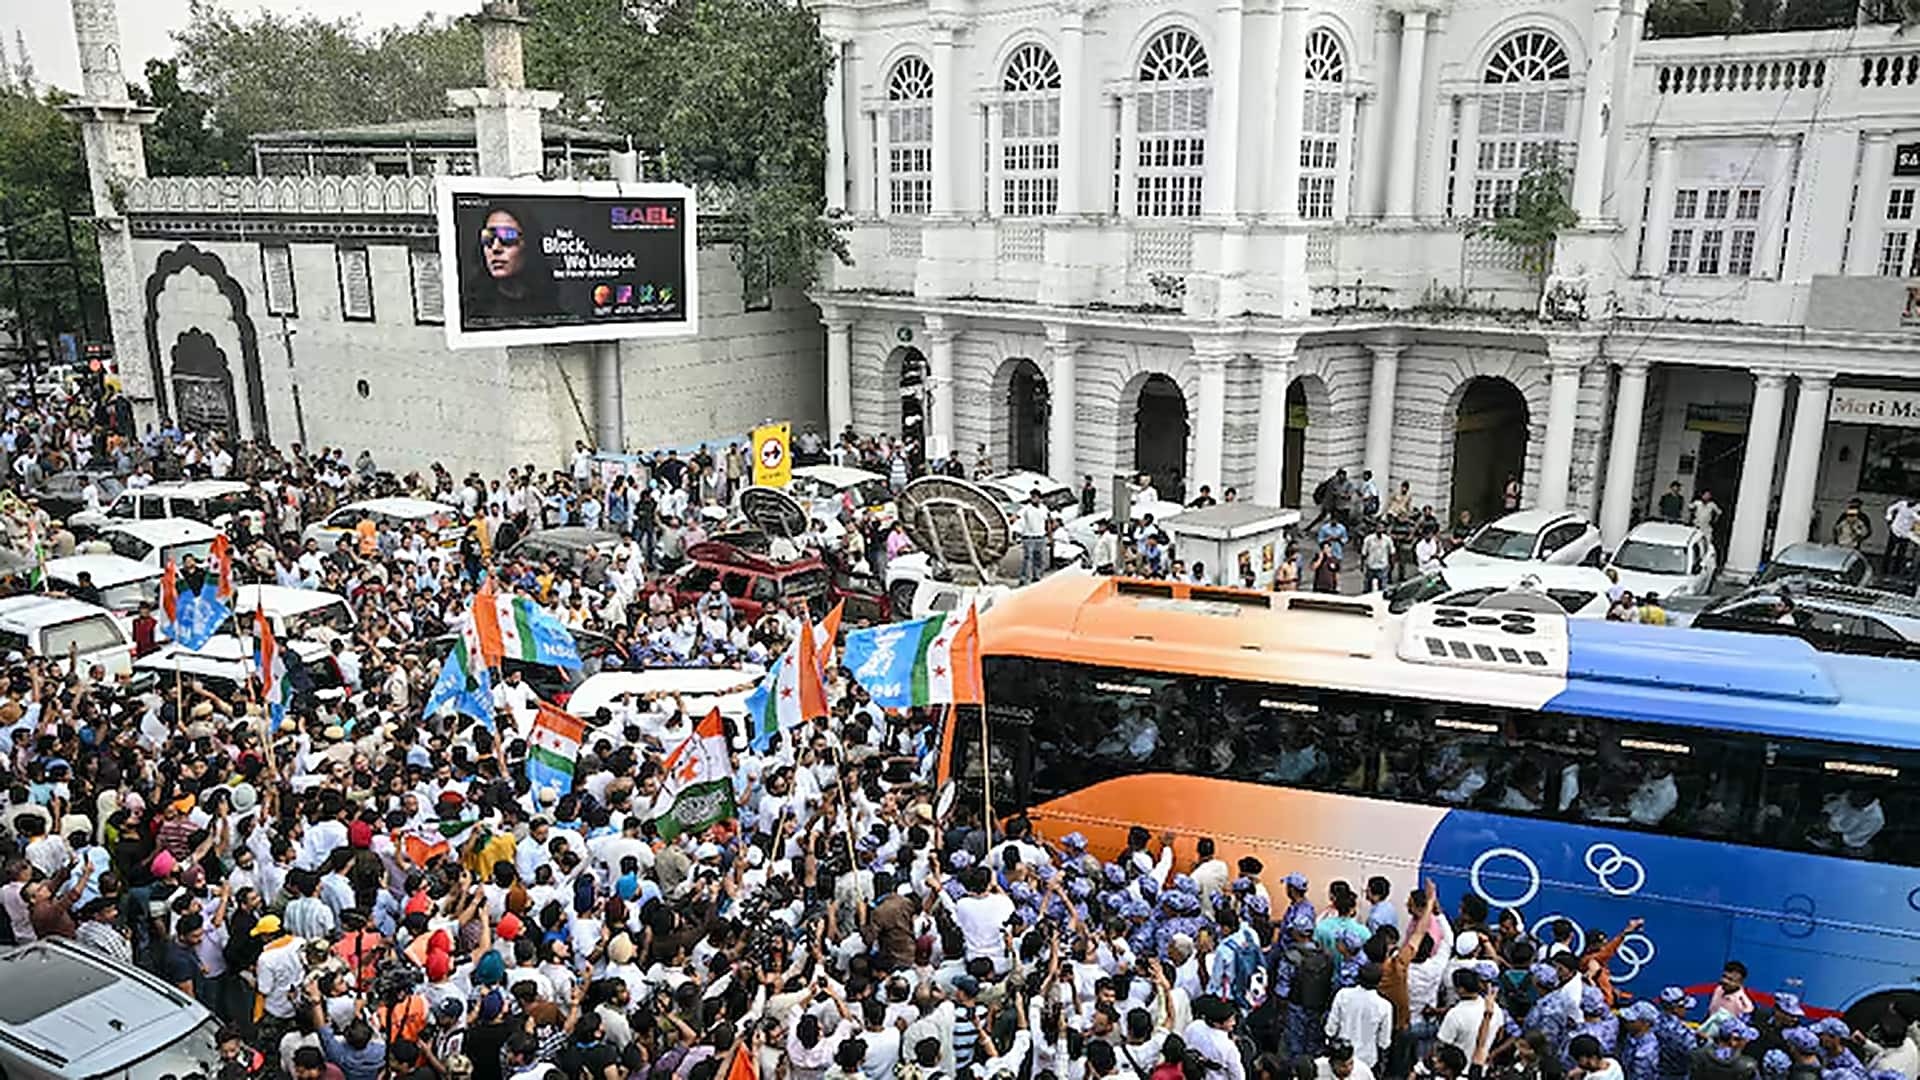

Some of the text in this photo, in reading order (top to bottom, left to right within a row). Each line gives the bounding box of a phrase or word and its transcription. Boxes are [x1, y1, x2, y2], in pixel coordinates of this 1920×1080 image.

[610, 206, 676, 224] SAEL
[543, 237, 590, 255] Block,
[563, 253, 636, 269] We Unlock
